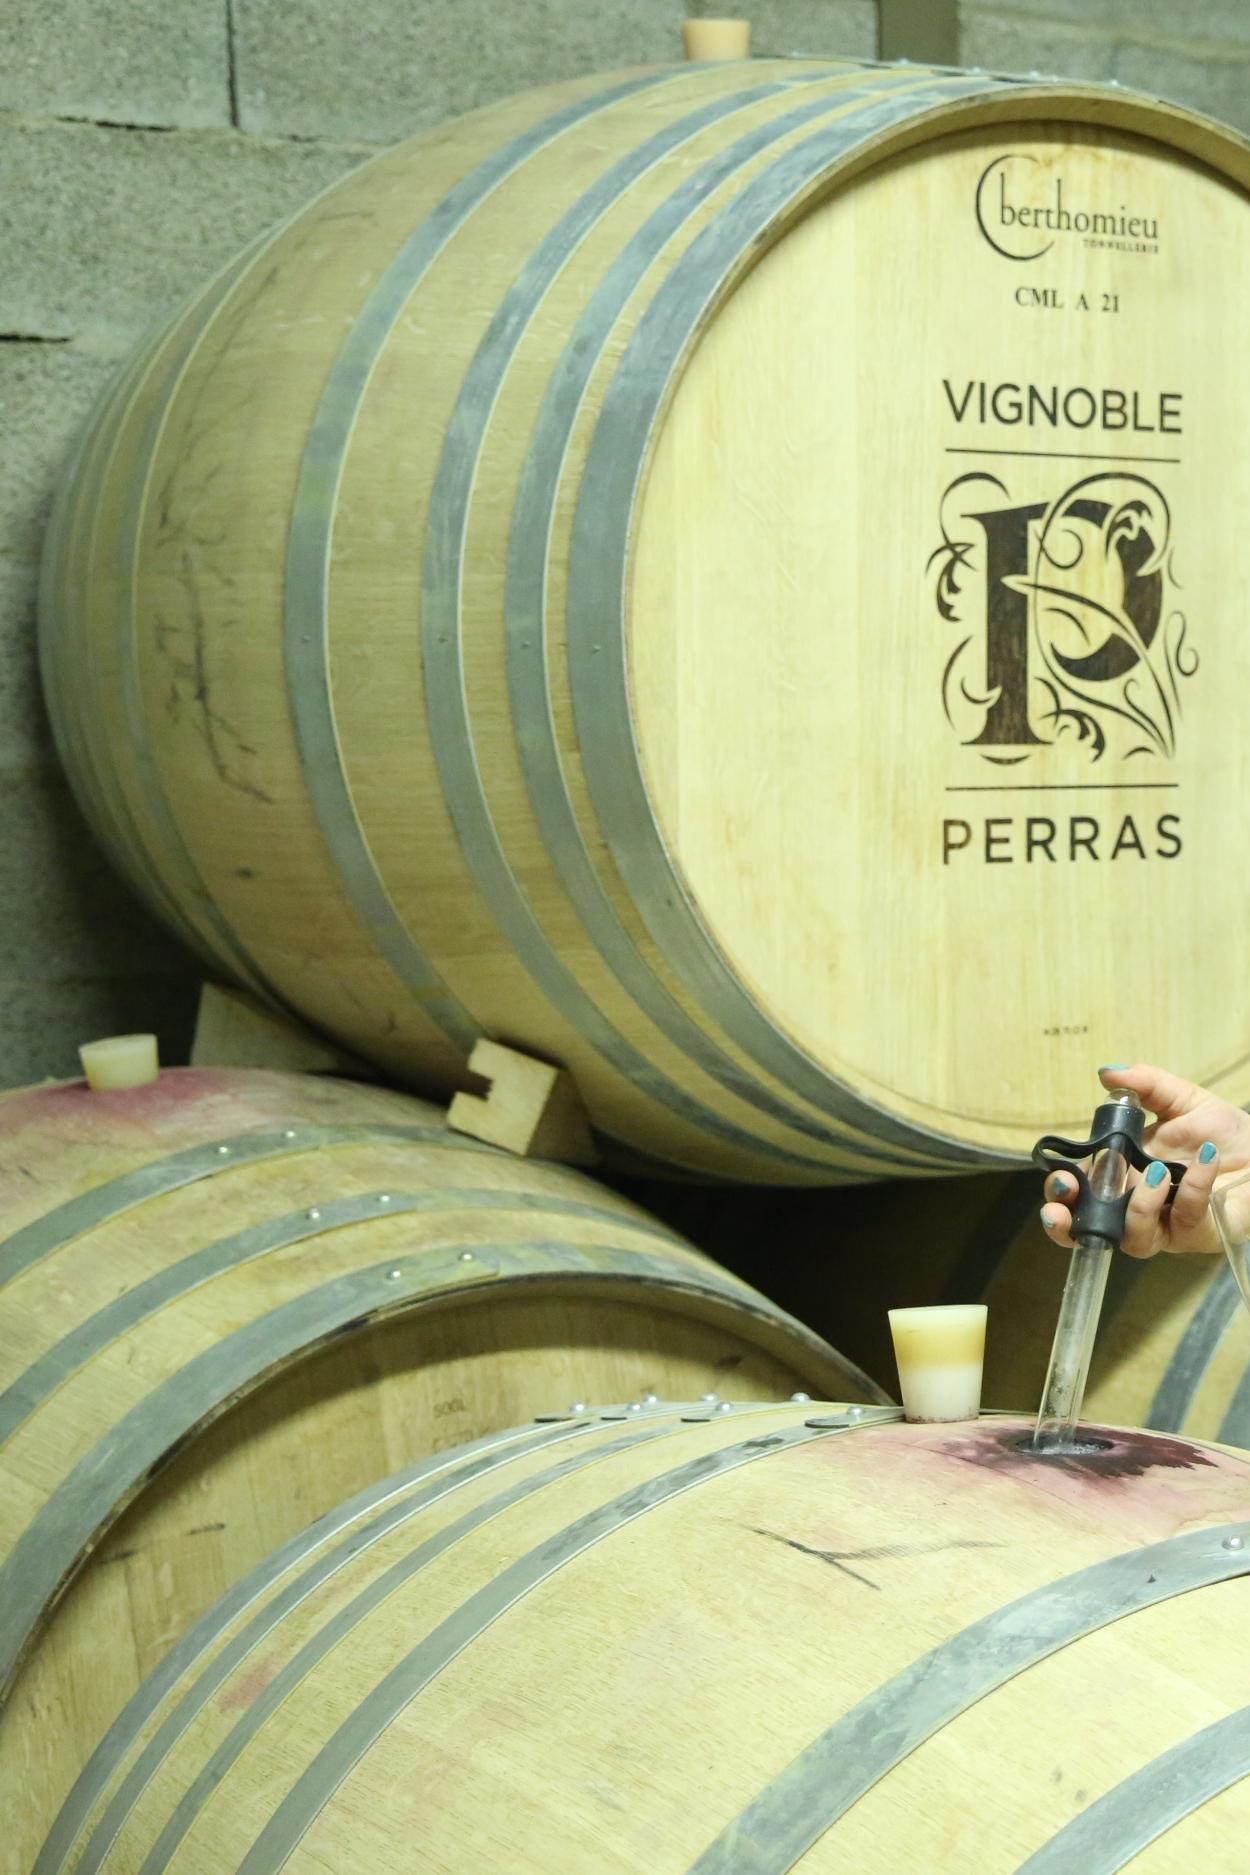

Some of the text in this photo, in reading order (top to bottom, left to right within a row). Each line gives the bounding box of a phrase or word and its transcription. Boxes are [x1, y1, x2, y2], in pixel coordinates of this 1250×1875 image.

[999, 170, 1159, 240] berthomieu
[1014, 285, 1120, 313] CML A 21
[942, 378, 1183, 434] VIGNOBLE
[942, 813, 1183, 866] PERRAS
